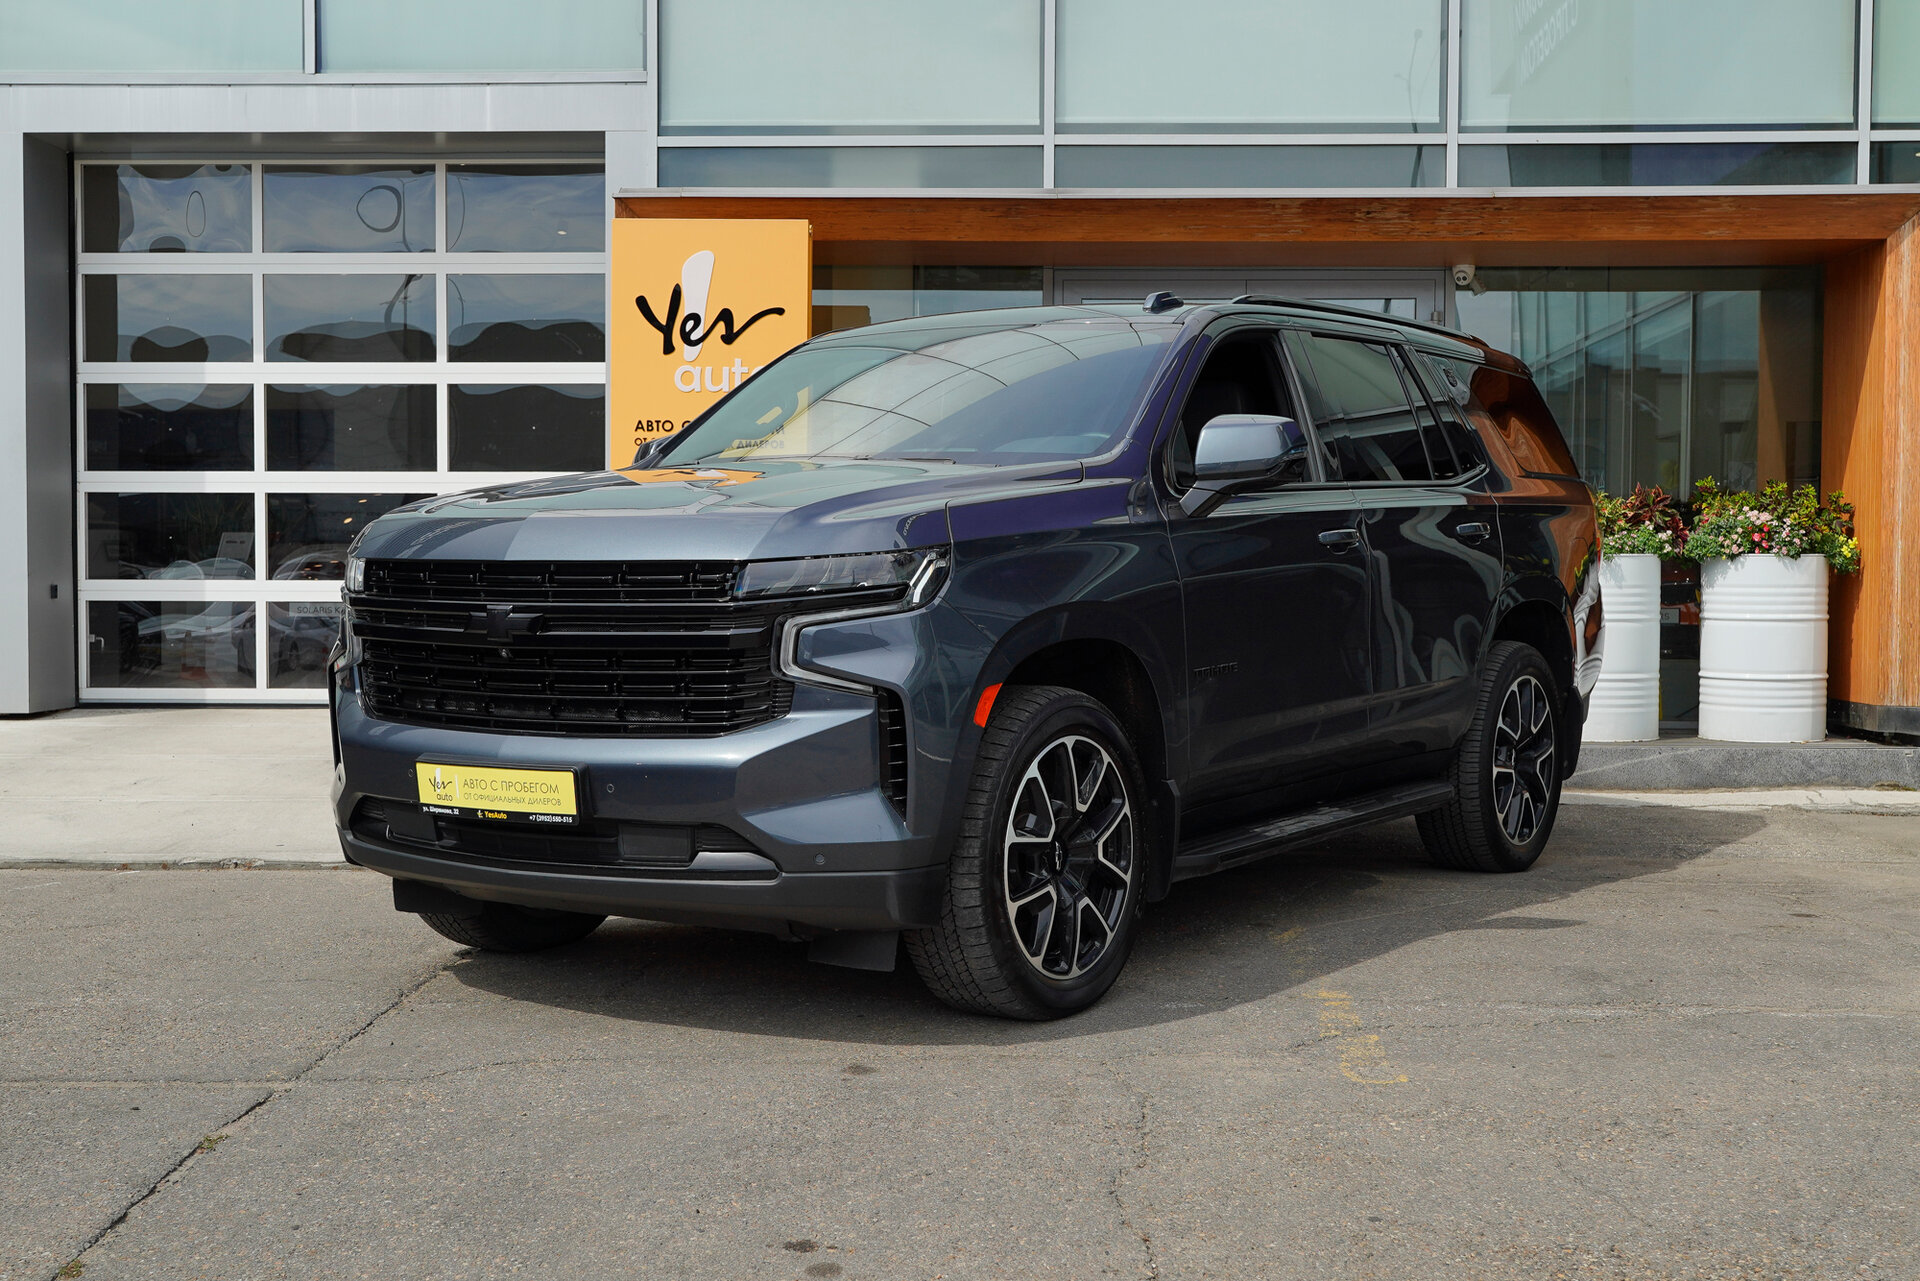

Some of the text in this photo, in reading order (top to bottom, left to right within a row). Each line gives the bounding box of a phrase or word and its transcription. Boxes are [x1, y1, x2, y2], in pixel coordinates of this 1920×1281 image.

[635, 283, 786, 355] Yes
[674, 358, 766, 393] aut
[634, 419, 674, 432] АВТО
[296, 606, 333, 614] SOLARIS
[428, 776, 452, 792] Yes
[463, 778, 560, 794] АВТО С ПРОБЕГОМ
[436, 793, 453, 802] auto
[463, 793, 562, 807] ОТ ОФИЦИАЛЬНЫХ ДИЛЕРОВ
[484, 811, 508, 820] YesAuto
